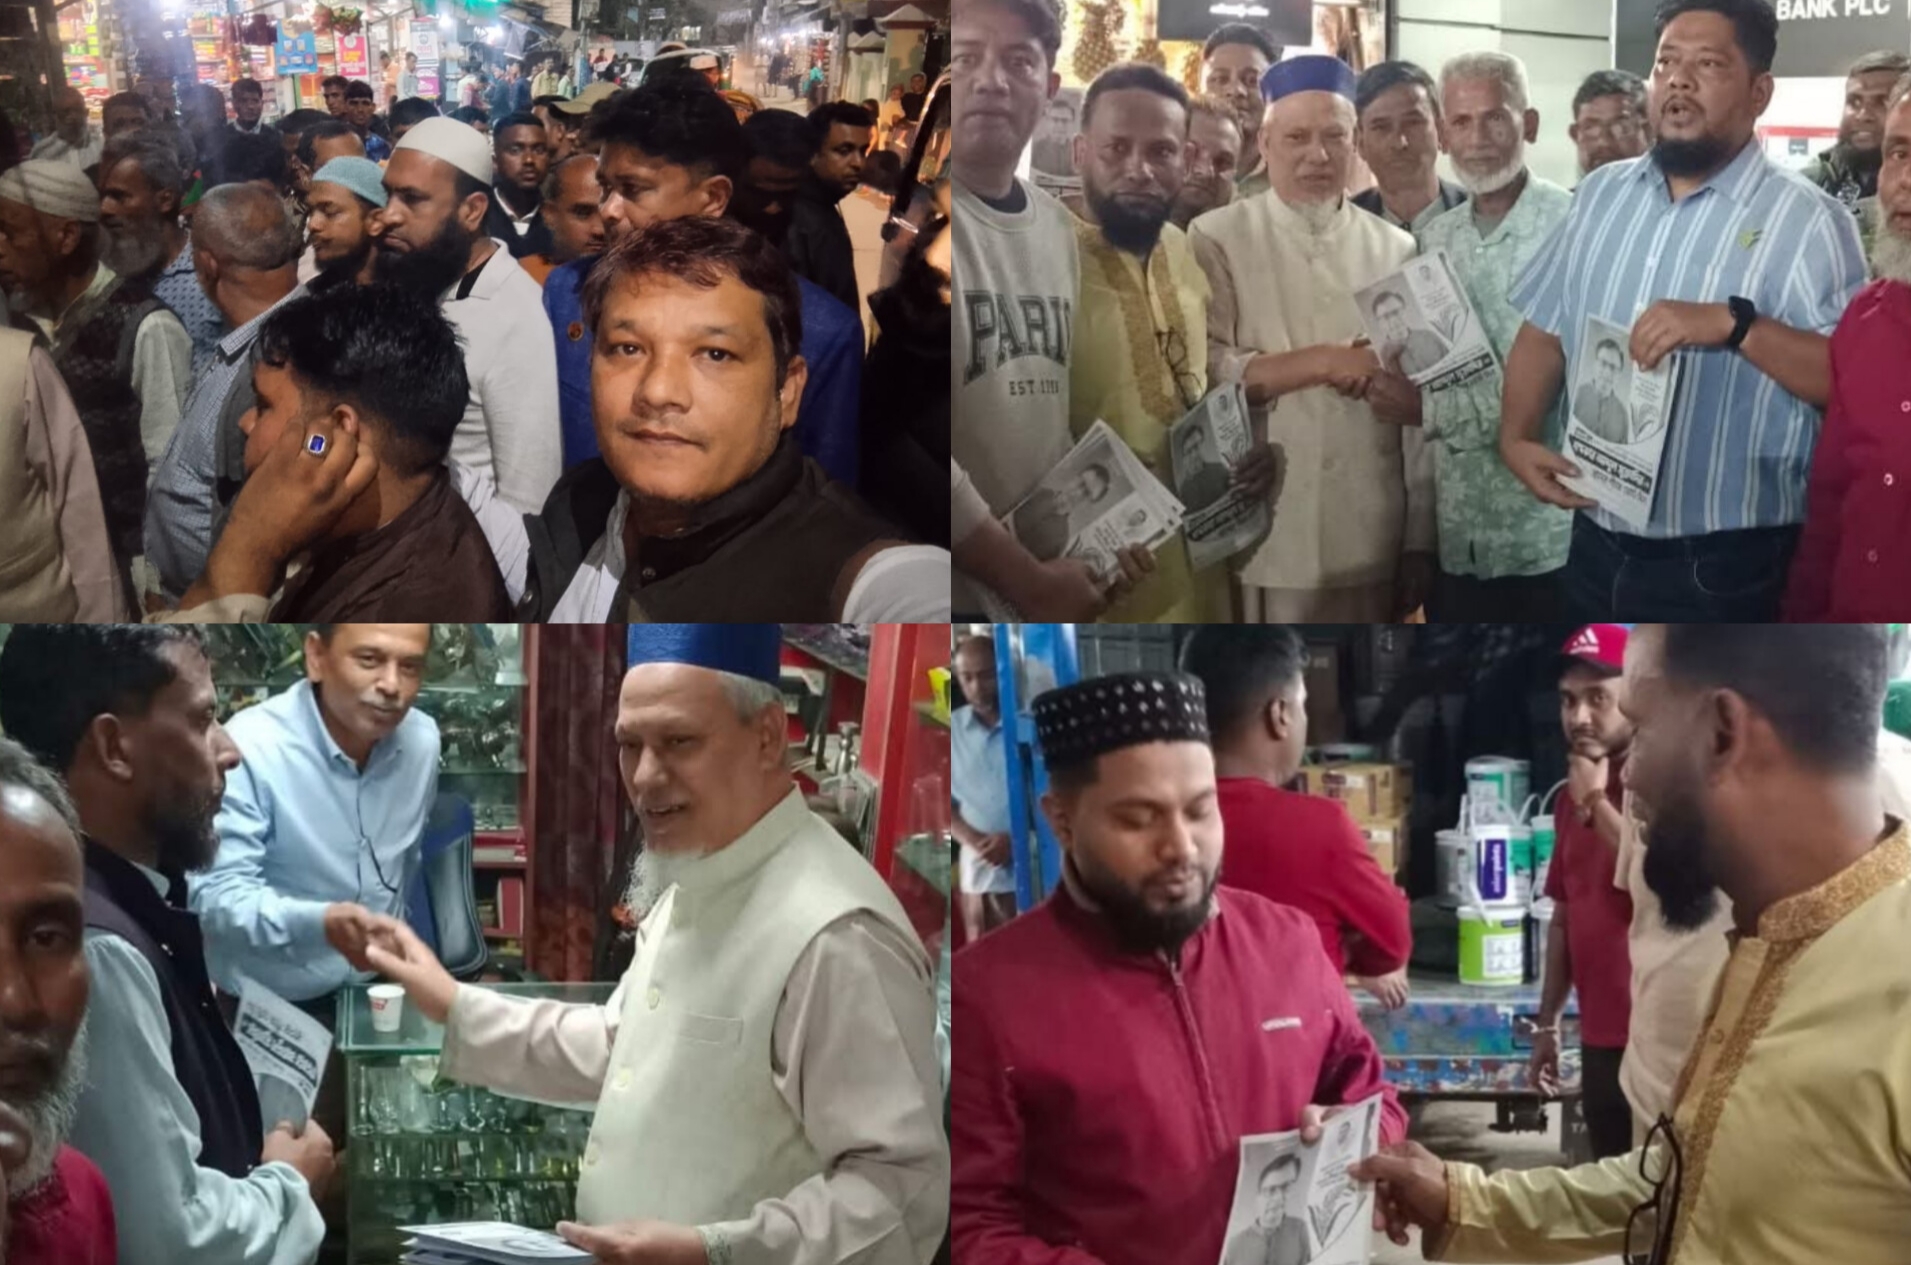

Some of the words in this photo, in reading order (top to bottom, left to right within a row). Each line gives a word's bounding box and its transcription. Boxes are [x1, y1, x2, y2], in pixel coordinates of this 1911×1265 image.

[1776, 0, 1838, 20] BANK
[1845, 0, 1891, 17] PLC
[962, 290, 1071, 387] PARI
